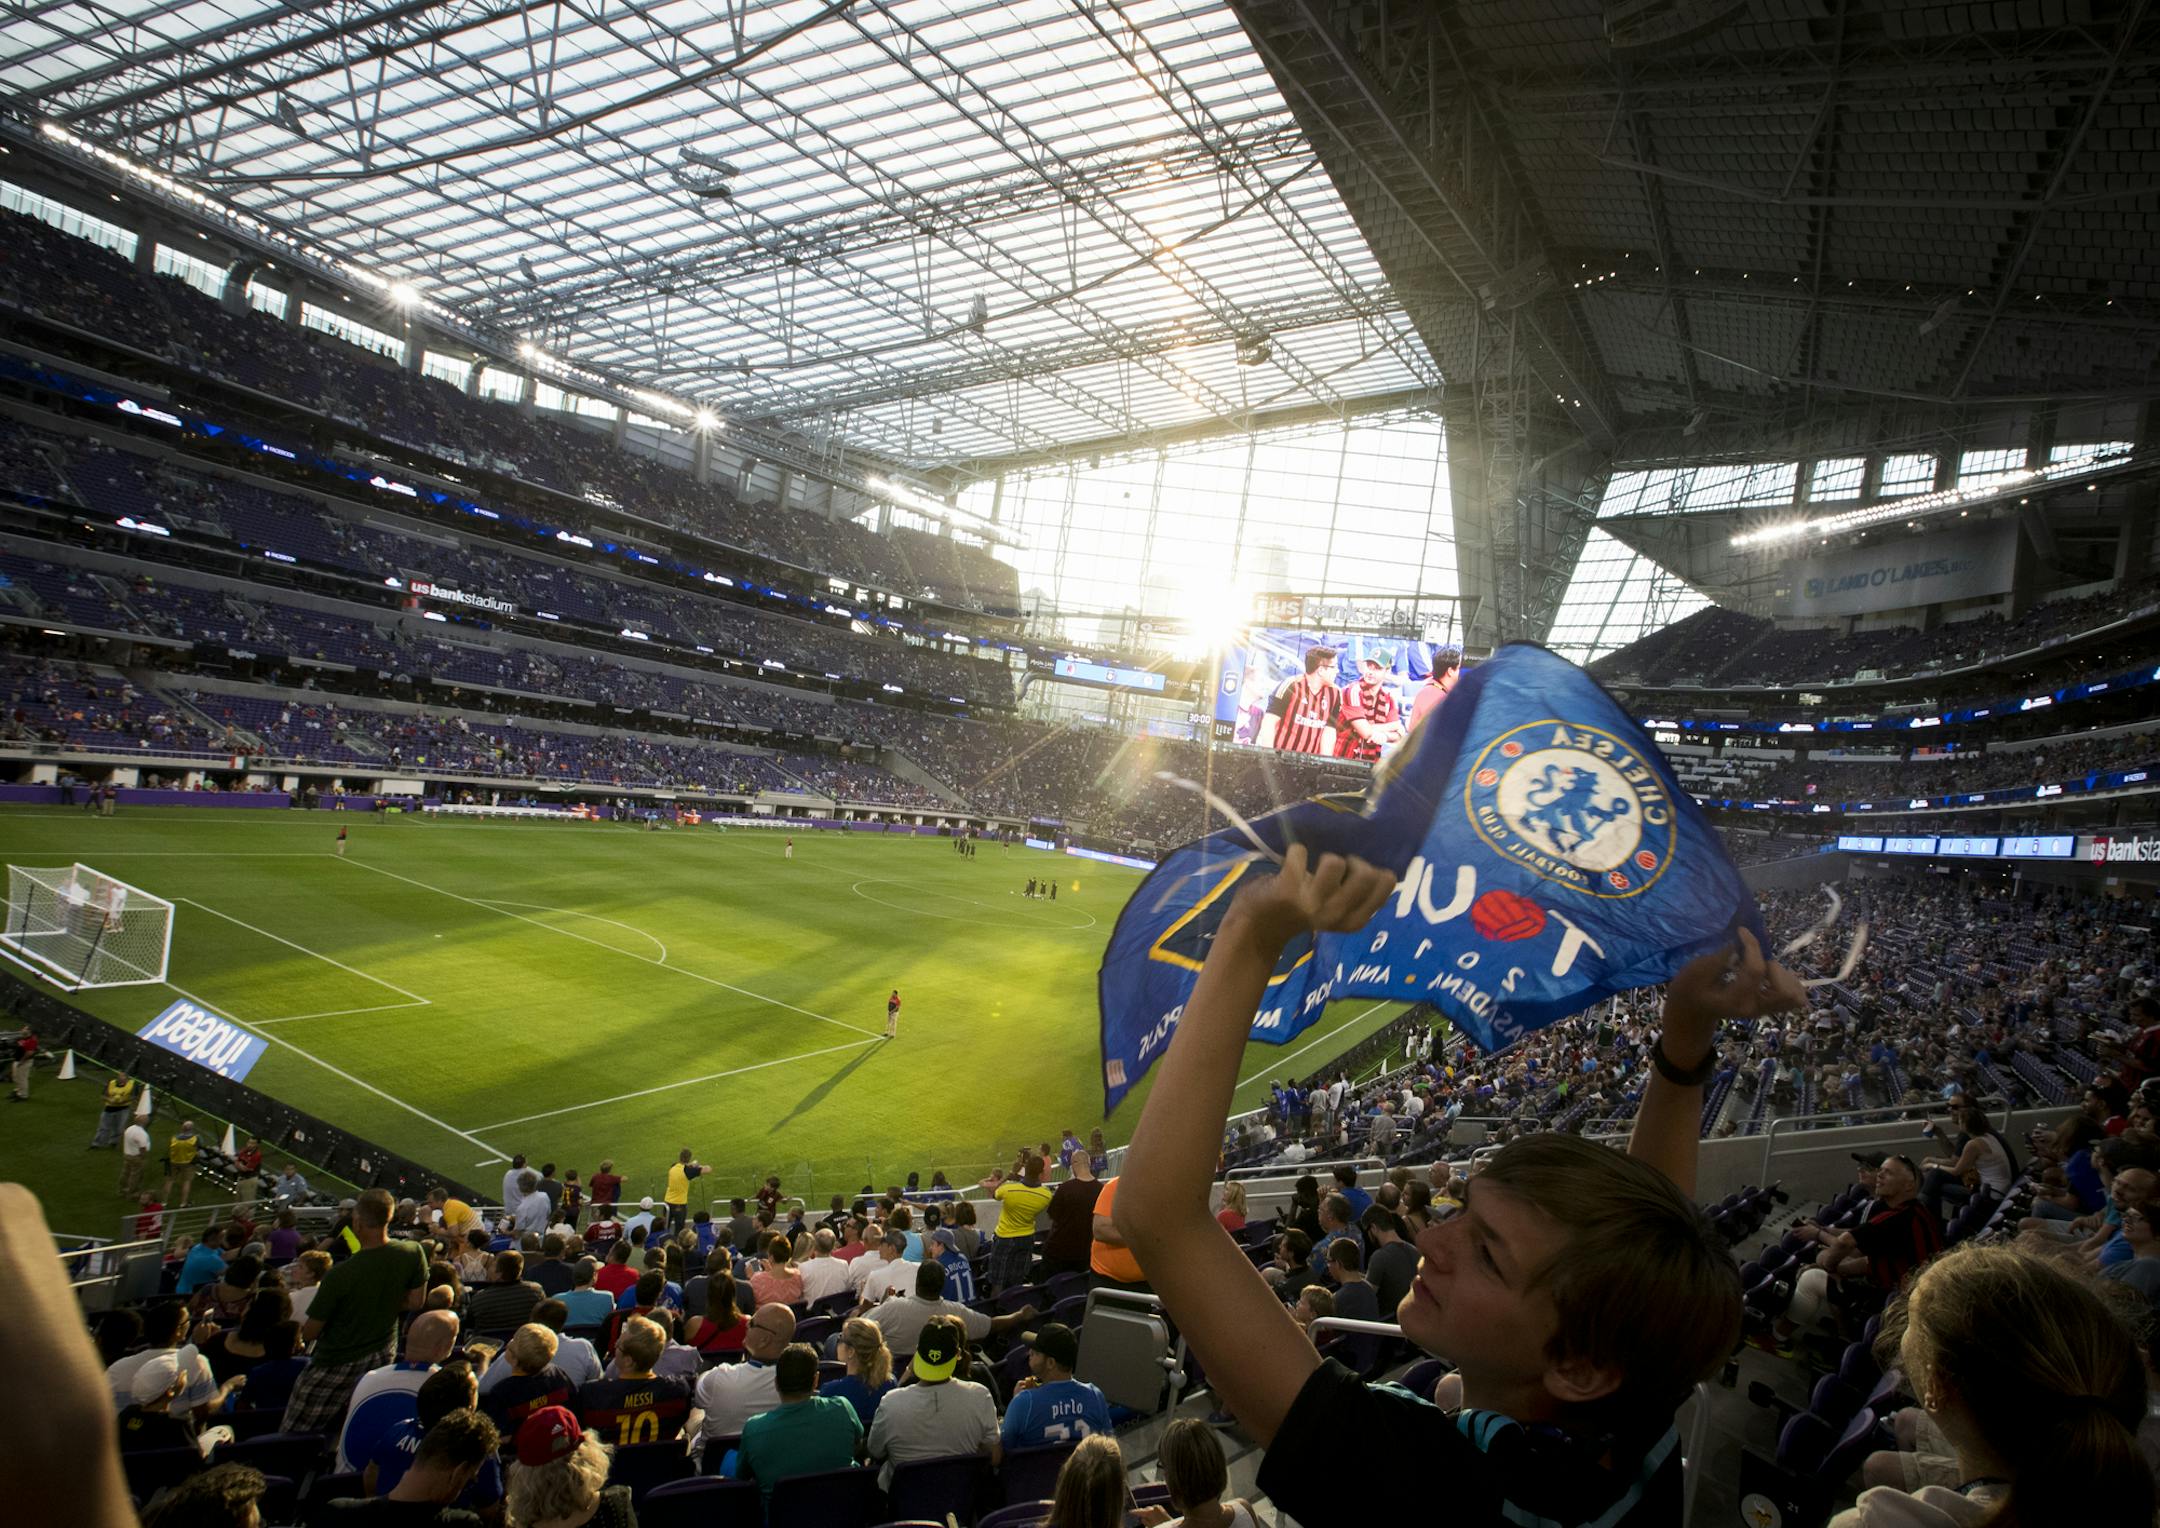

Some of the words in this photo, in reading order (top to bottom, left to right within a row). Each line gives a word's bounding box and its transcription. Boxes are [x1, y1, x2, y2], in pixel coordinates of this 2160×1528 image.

[1188, 712, 1211, 725] 30:00
[141, 1002, 252, 1077] indeed
[949, 1269, 977, 1303] 11
[623, 1391, 654, 1409] MESSI
[1051, 1398, 1083, 1420] pirlo
[615, 1410, 660, 1446] 10
